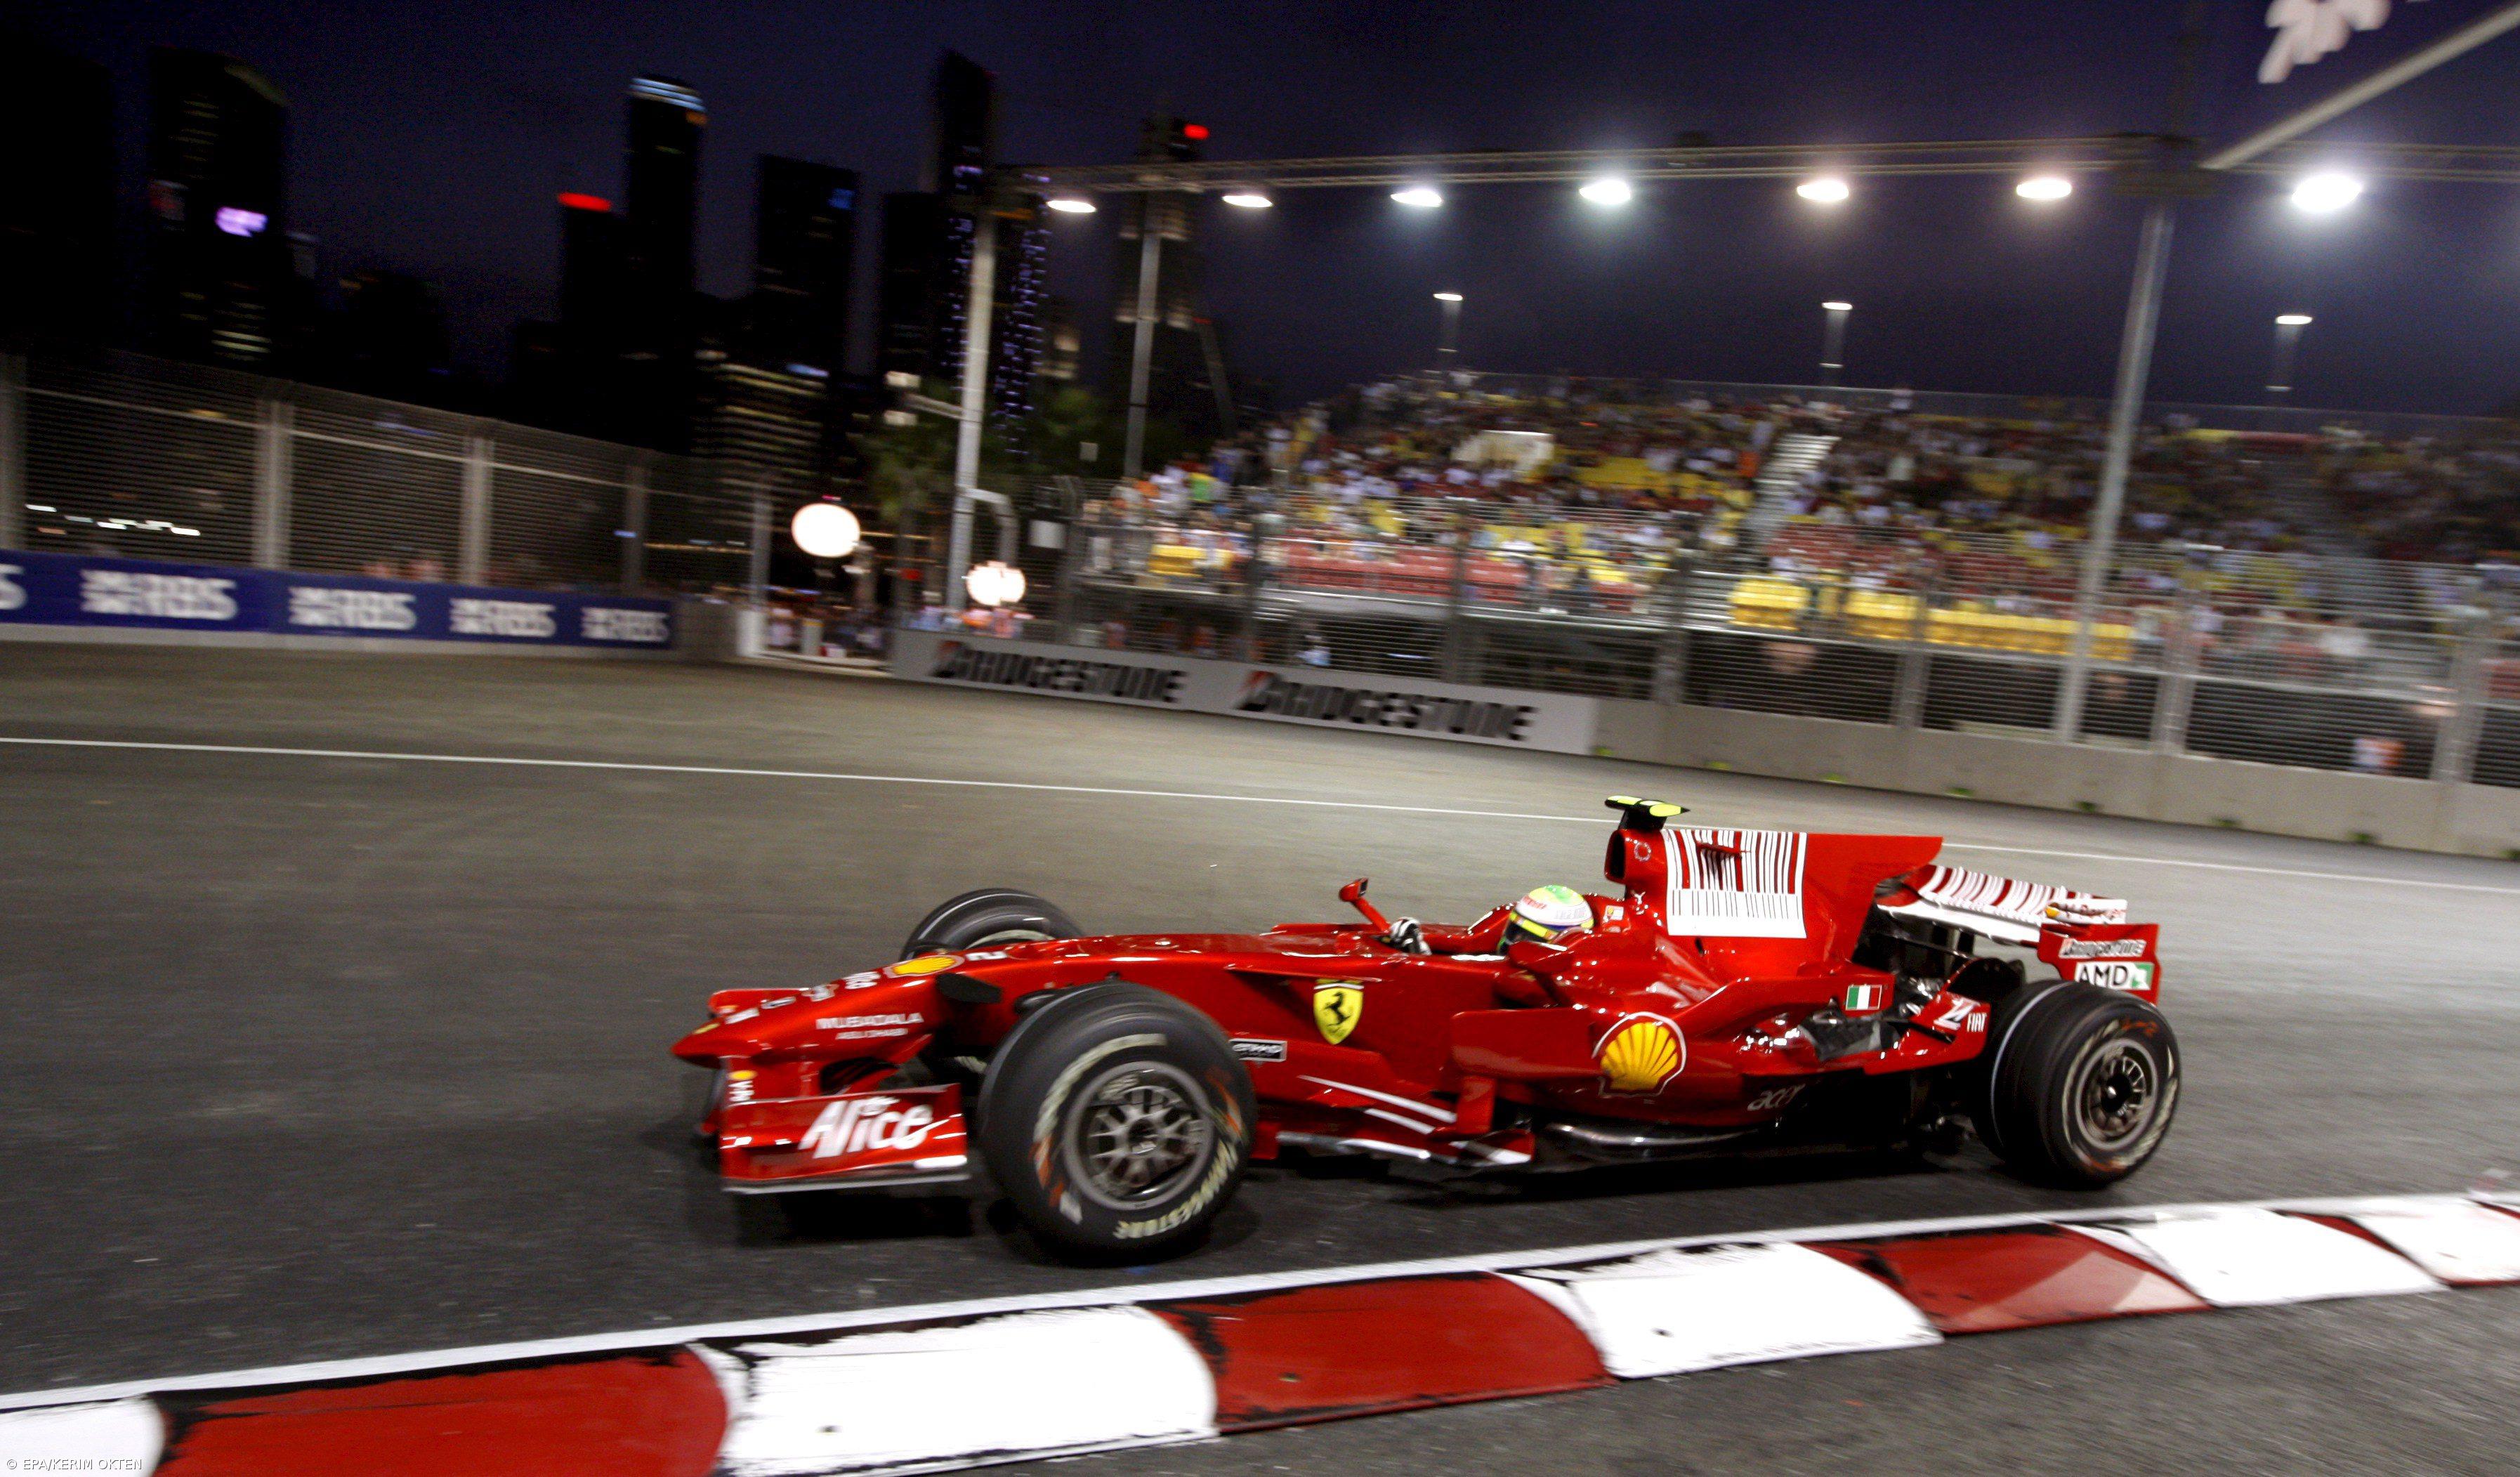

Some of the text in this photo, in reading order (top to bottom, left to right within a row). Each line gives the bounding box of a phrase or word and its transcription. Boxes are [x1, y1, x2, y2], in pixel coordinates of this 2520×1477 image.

[929, 640, 1187, 703] BRIDGESTONE
[1235, 671, 1540, 740] BRIDGESTONE
[2079, 965, 2128, 987] AMD
[1967, 1013, 1988, 1032] FIAT
[798, 1096, 947, 1159] Alice
